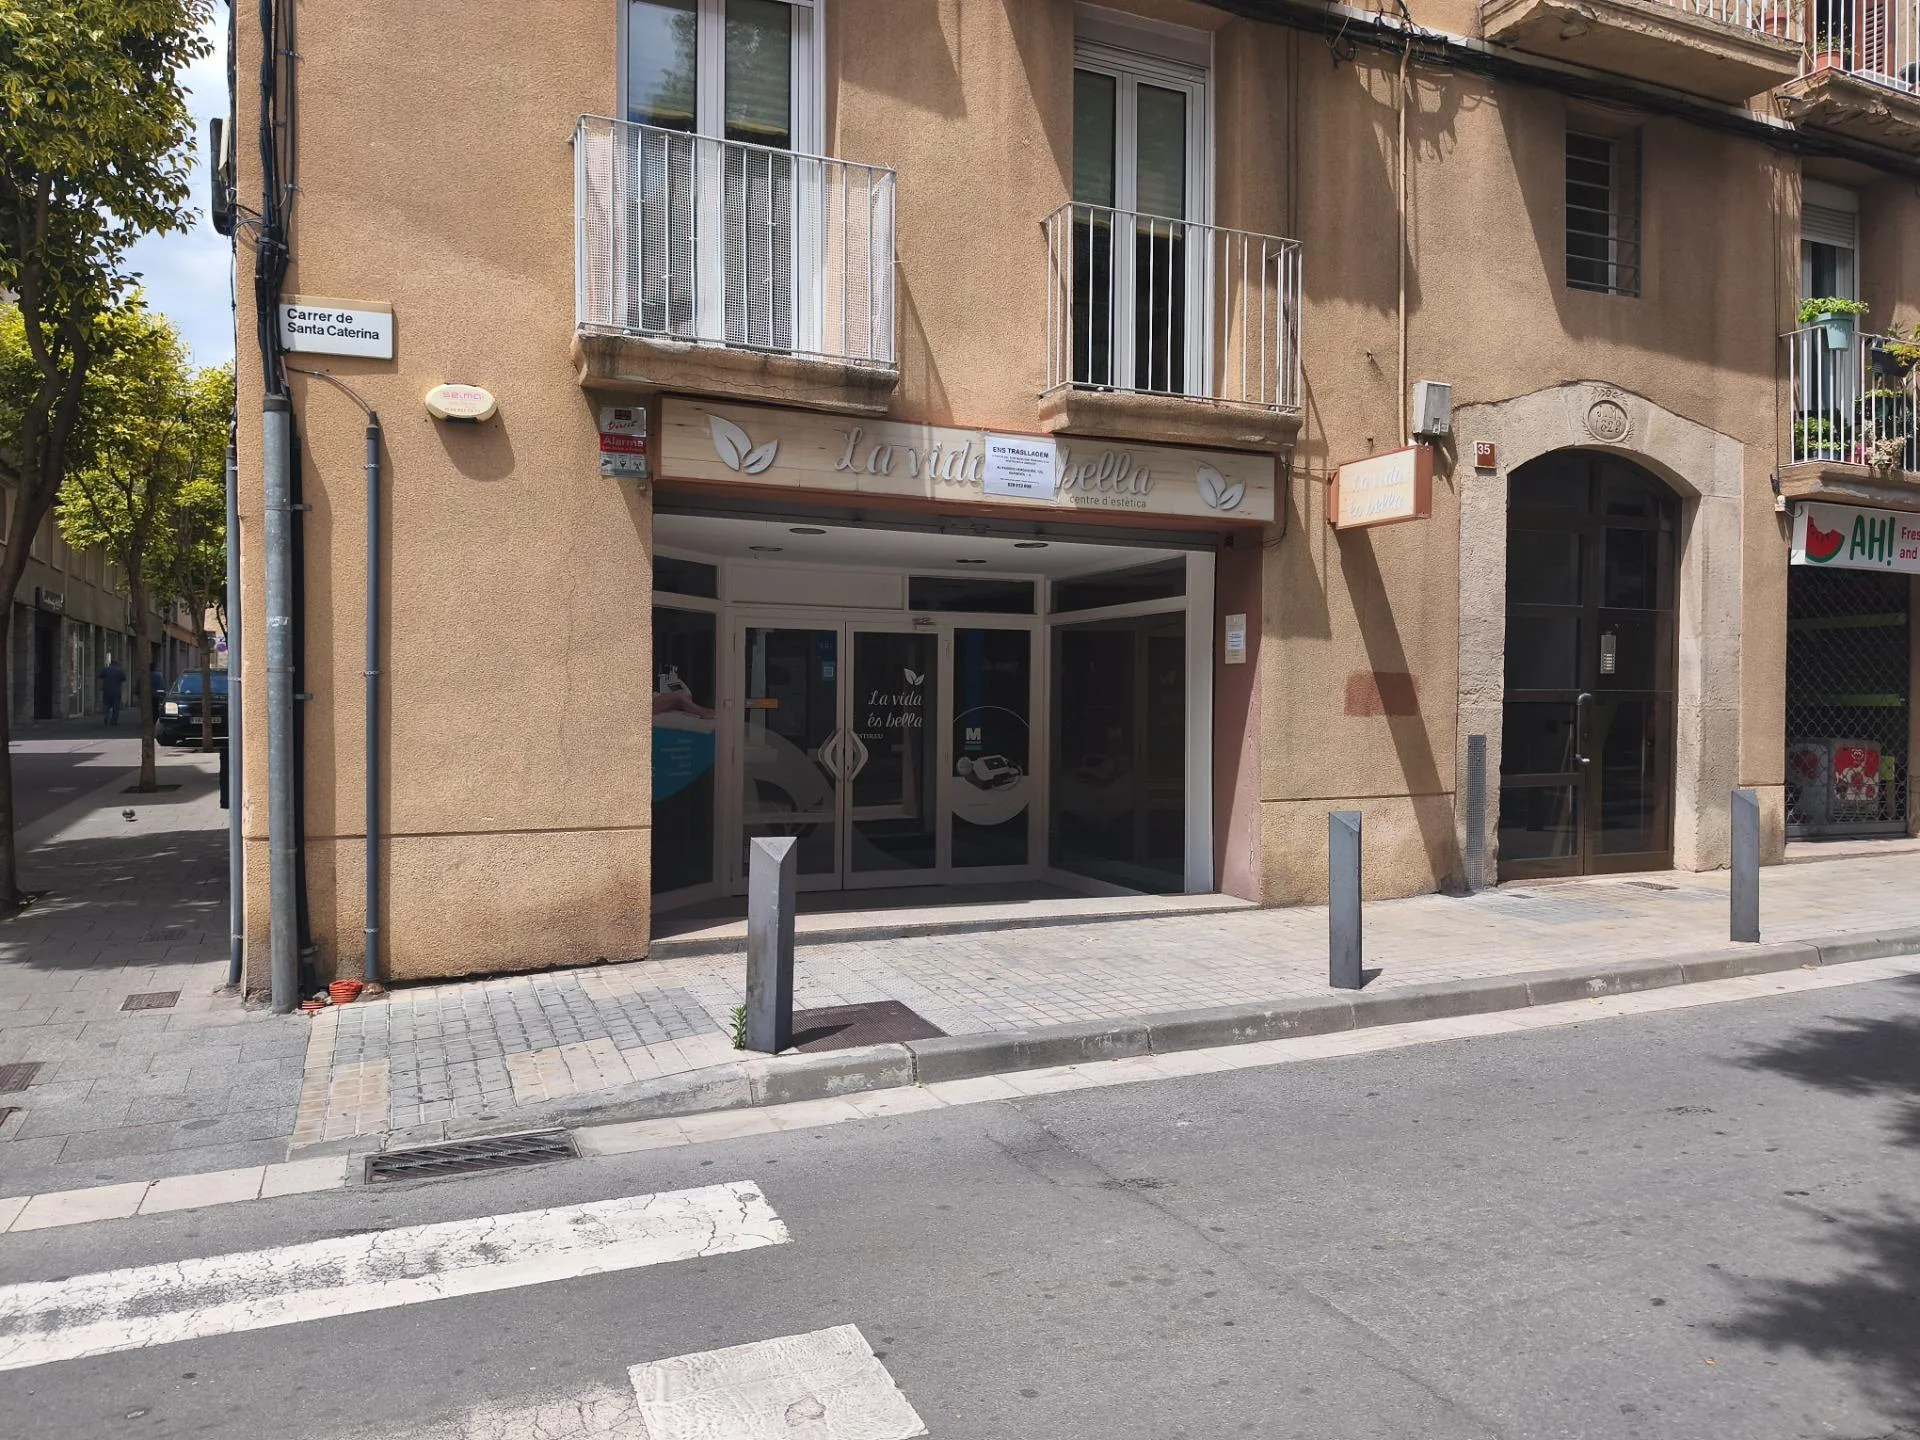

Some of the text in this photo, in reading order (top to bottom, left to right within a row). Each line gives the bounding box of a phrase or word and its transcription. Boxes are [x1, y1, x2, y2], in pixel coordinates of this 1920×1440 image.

[287, 308, 353, 324] Carrer de
[287, 322, 380, 340] Santa Caterina
[603, 435, 644, 447] Alarma
[992, 446, 1006, 454] ENS
[1007, 448, 1049, 459] TRASLLADEM
[1477, 443, 1491, 455] 35
[834, 426, 897, 476] La
[1055, 444, 1155, 496] bella
[1069, 495, 1147, 509] centre d'estètica
[1849, 514, 1896, 566] AH!
[1899, 547, 1918, 560] and
[868, 689, 922, 706] La vida
[867, 712, 923, 728] és bella
[965, 727, 982, 741] M
